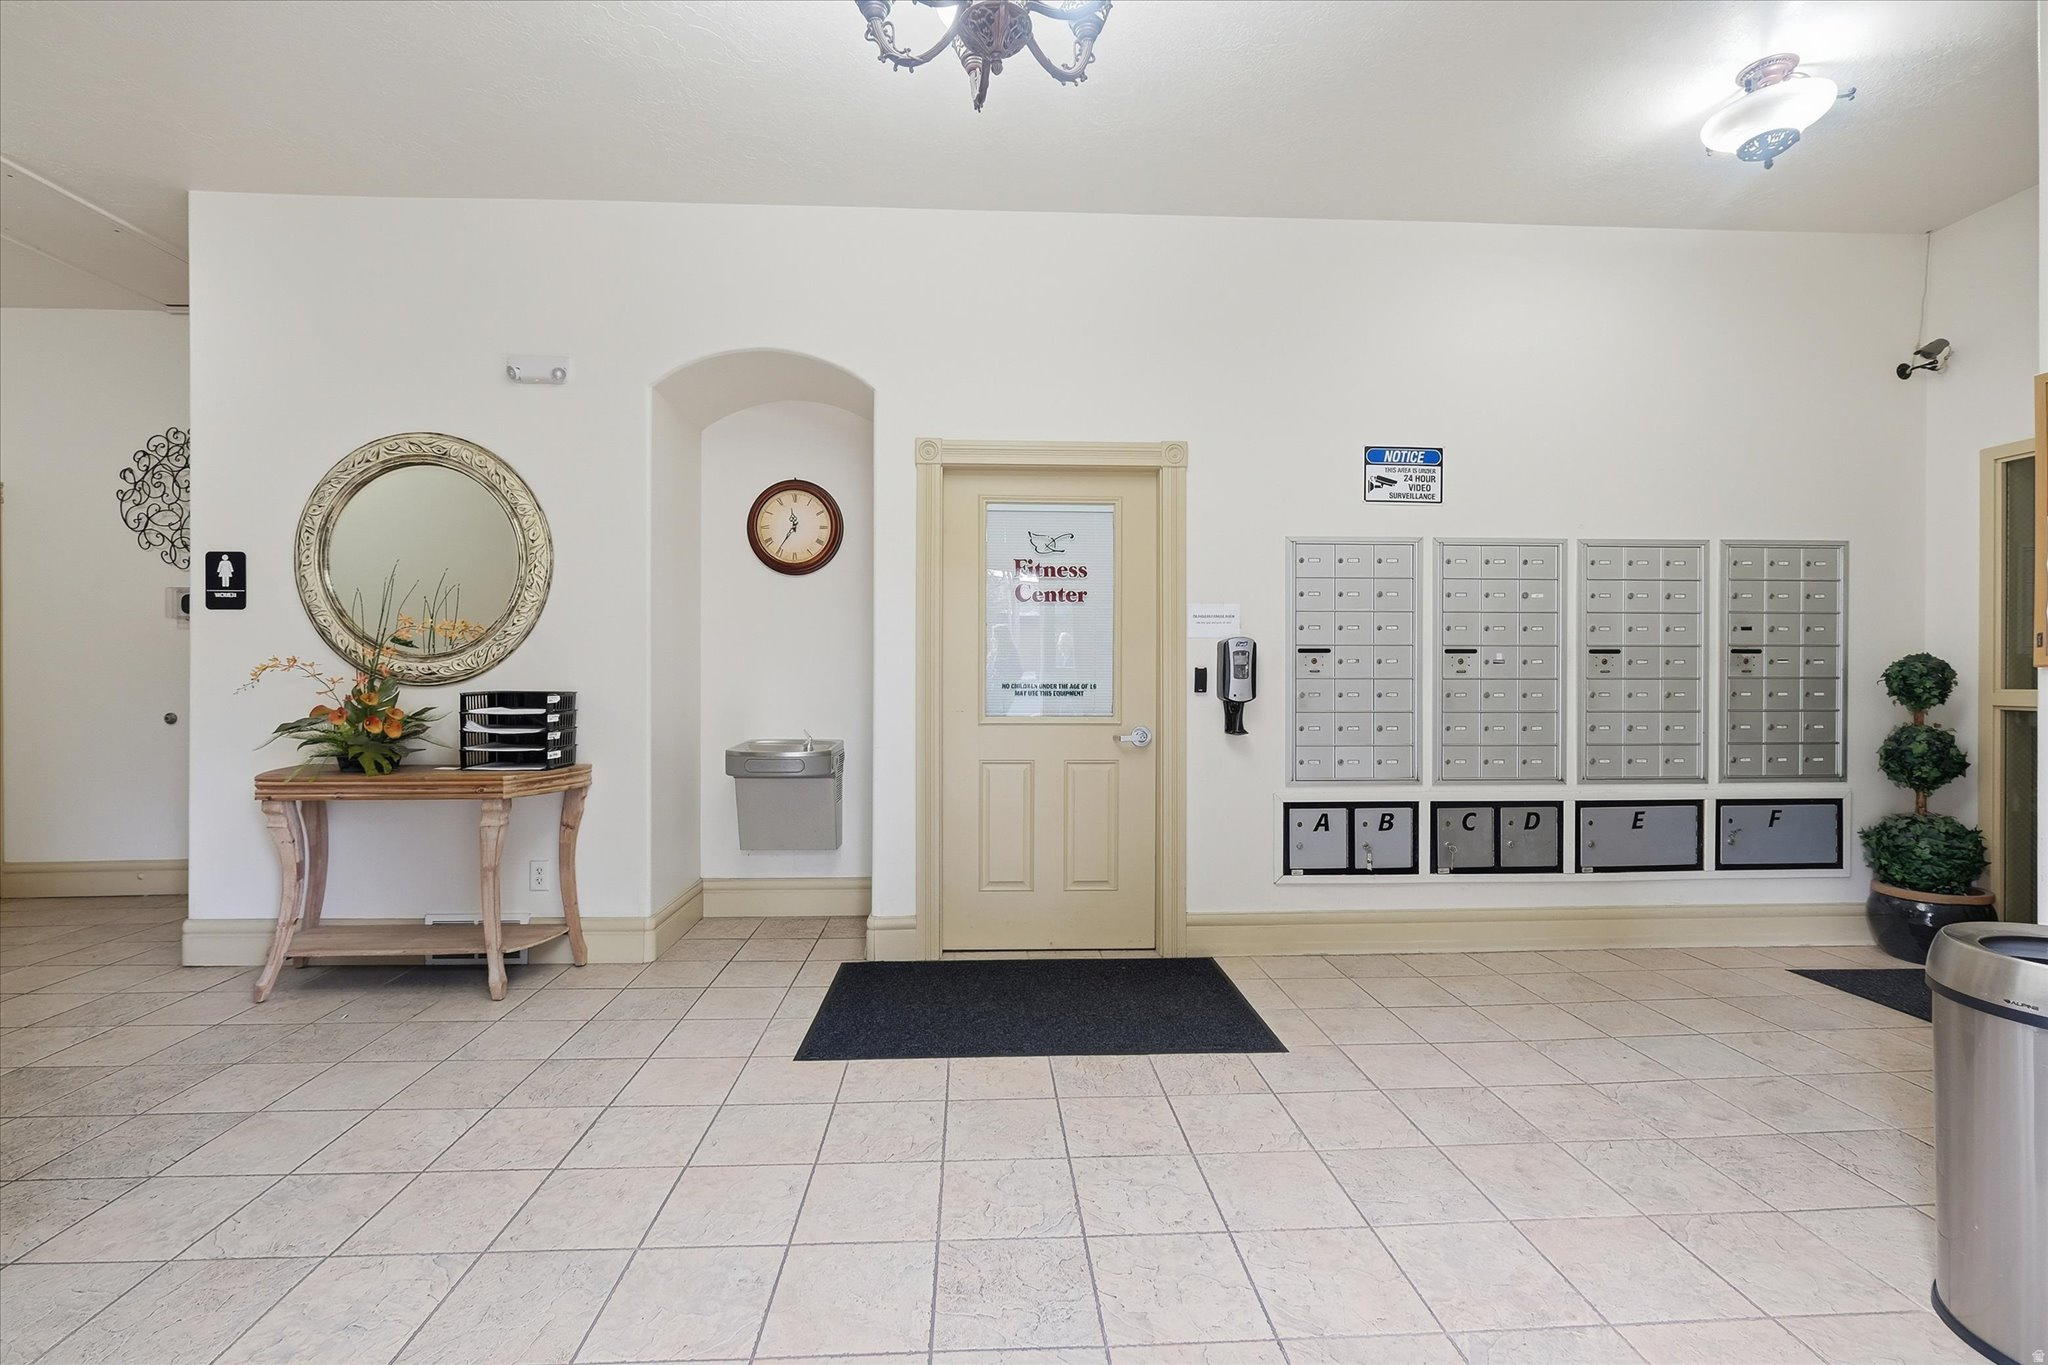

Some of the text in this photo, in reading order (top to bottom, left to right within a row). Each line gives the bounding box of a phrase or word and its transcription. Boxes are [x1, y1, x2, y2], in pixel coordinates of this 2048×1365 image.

[1384, 450, 1425, 463] NOTICE
[1403, 474, 1436, 483] 24 HOUR
[1389, 492, 1436, 500] SURVEILLANCE
[1408, 484, 1431, 492] VIDEO
[1013, 558, 1088, 578] Fitness
[1014, 583, 1088, 602] Center
[1313, 813, 1330, 832] A
[1378, 813, 1395, 831] B
[1462, 812, 1477, 831] C
[1524, 812, 1540, 830] D
[1632, 811, 1646, 830] E
[1768, 809, 1782, 828] F
